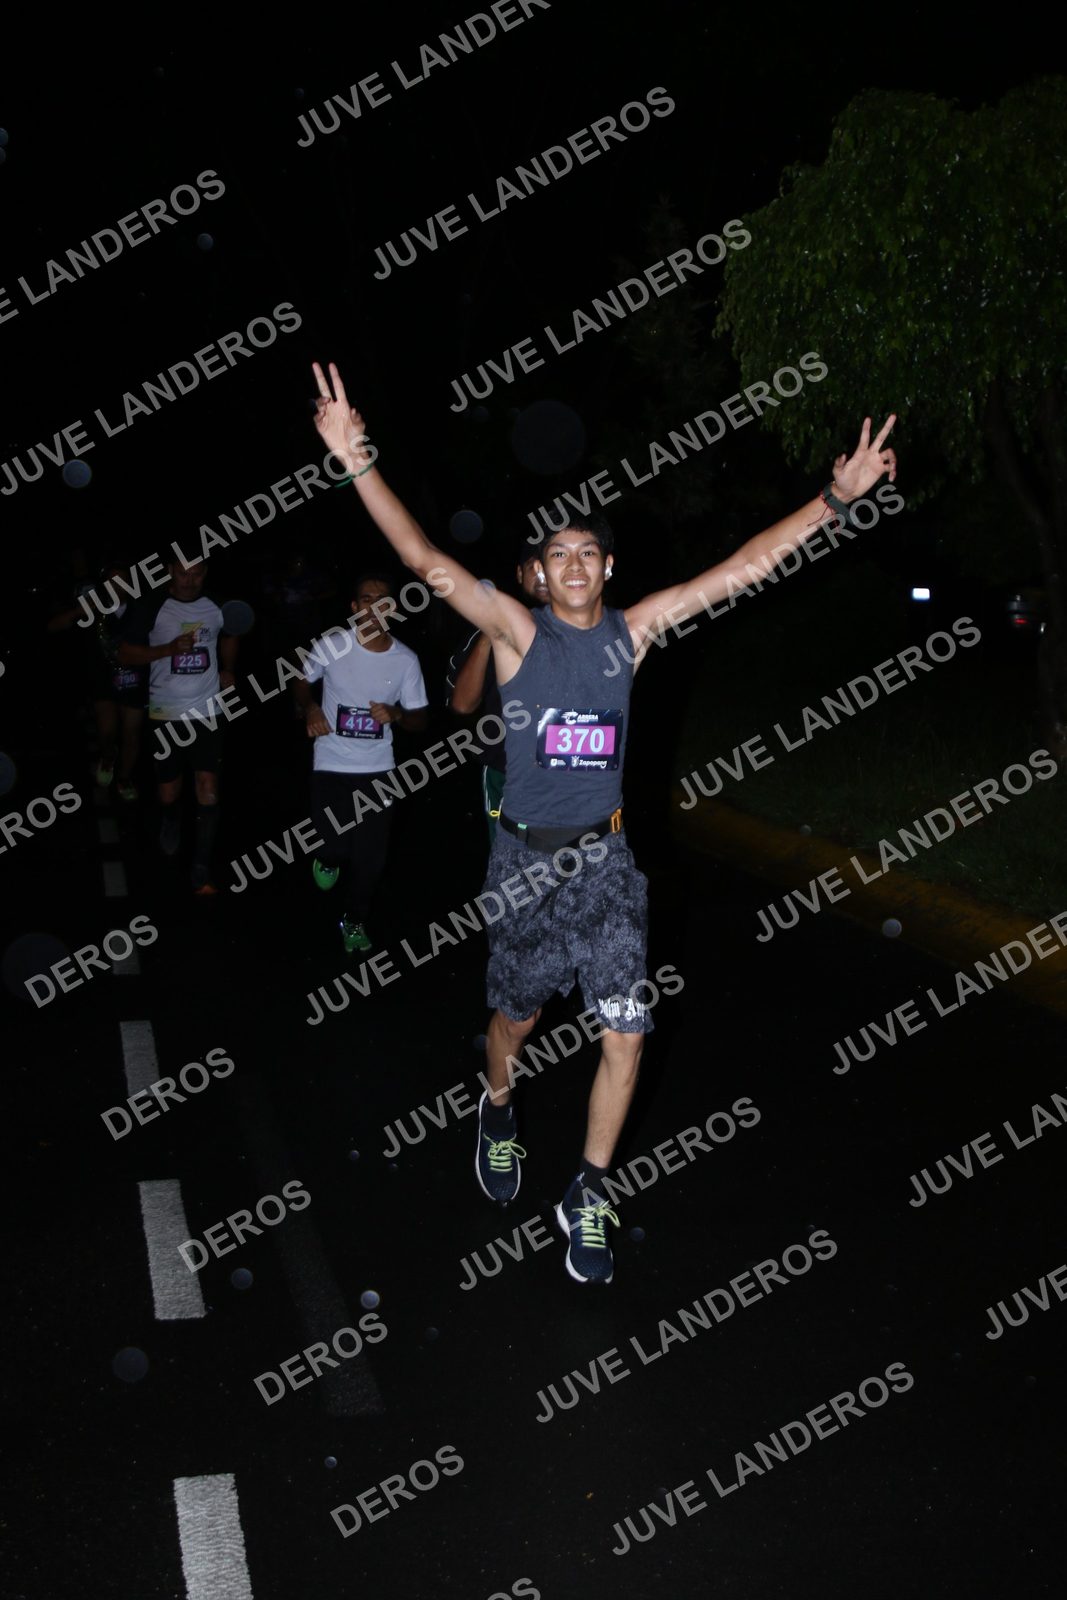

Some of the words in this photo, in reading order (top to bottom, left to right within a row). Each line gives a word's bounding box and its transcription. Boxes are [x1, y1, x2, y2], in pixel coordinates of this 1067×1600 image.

[179, 655, 202, 667] 225
[345, 715, 374, 730] 412
[556, 727, 605, 753] 370
